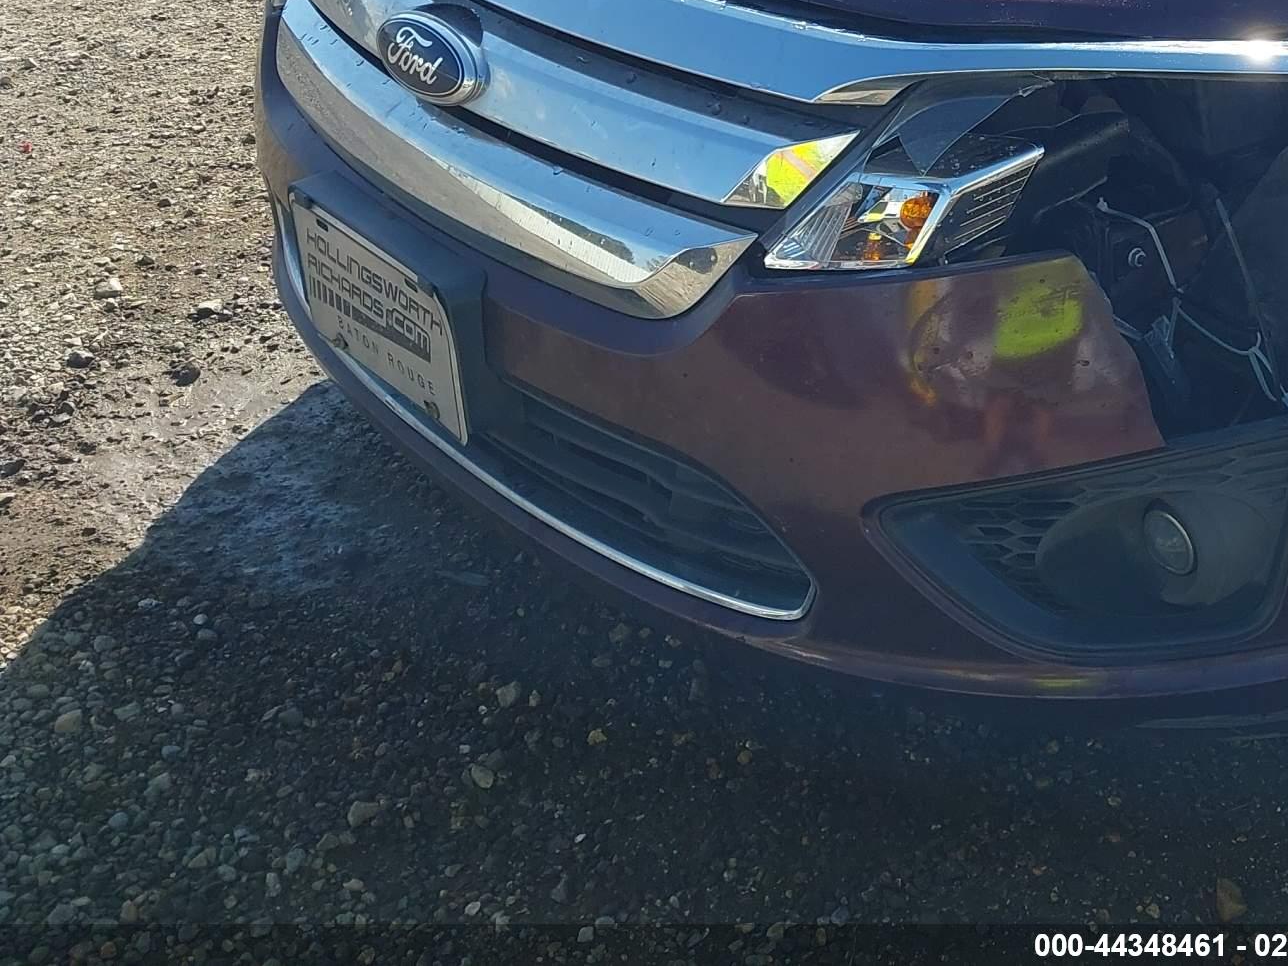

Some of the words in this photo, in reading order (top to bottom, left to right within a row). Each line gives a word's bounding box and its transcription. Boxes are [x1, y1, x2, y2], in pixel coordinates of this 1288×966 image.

[387, 26, 443, 85] Ford
[306, 227, 443, 336] HOLLINGSWORTH
[337, 314, 379, 355] BATON
[387, 352, 435, 396] ROUGE
